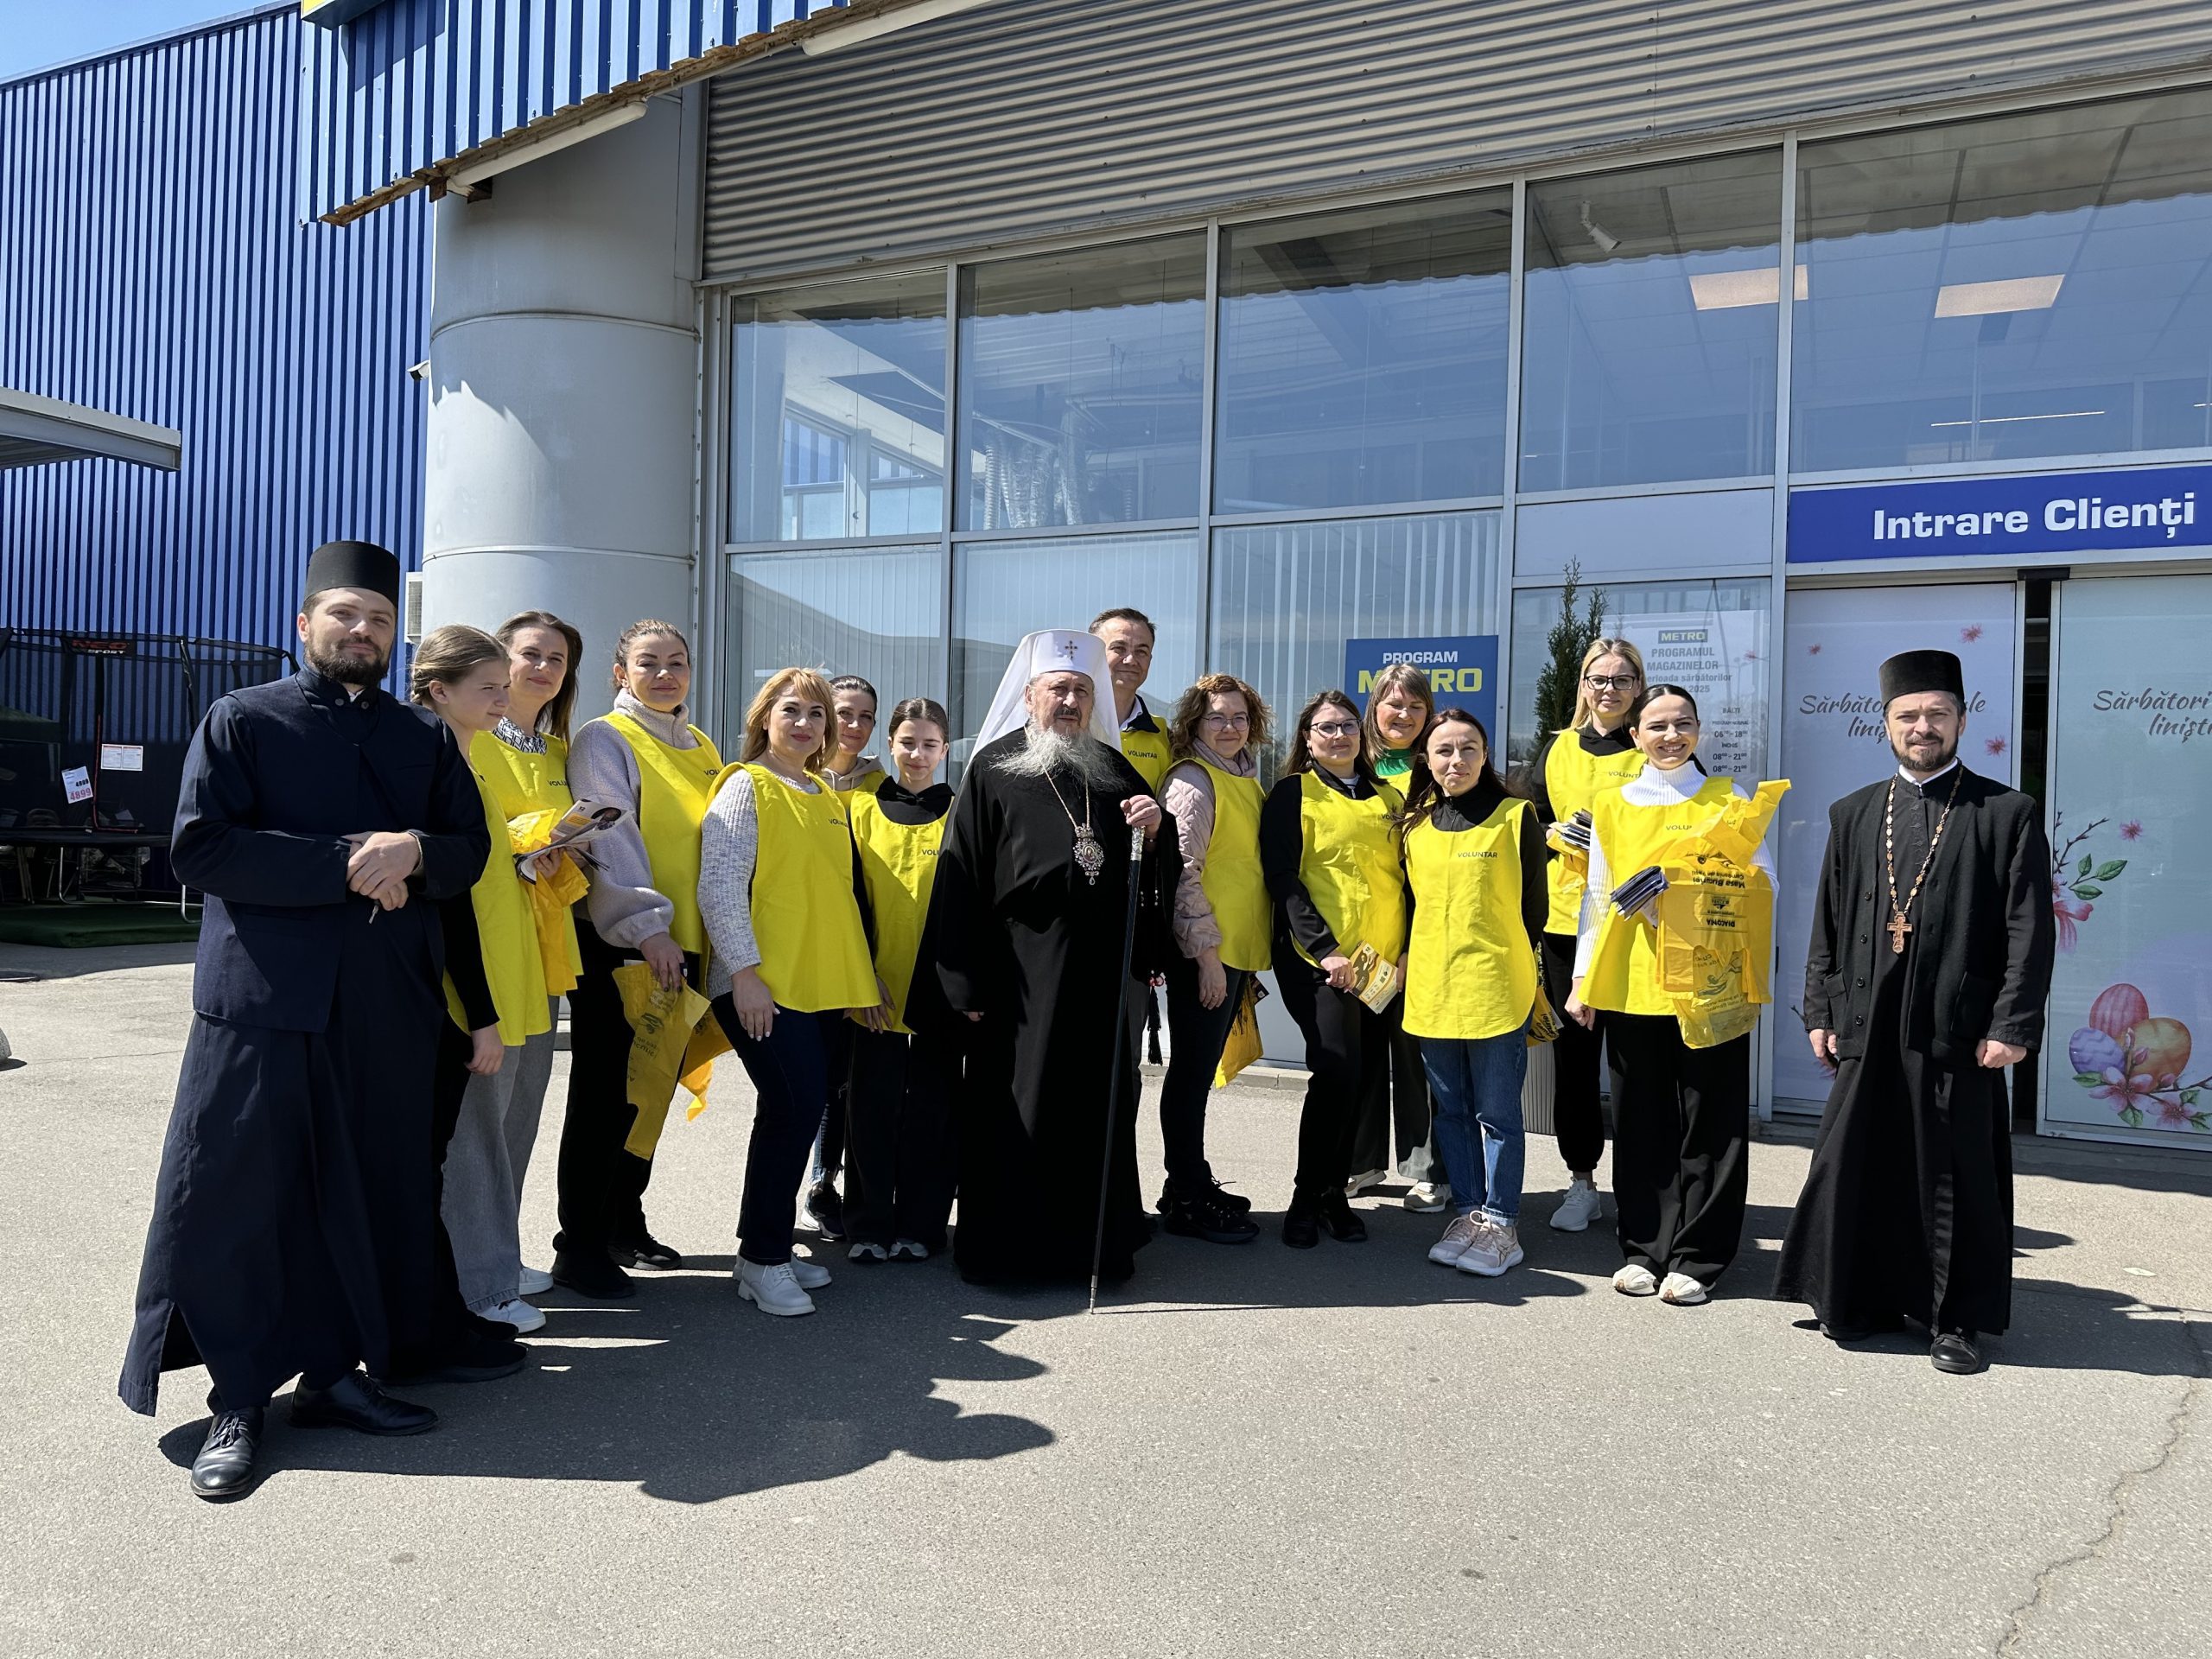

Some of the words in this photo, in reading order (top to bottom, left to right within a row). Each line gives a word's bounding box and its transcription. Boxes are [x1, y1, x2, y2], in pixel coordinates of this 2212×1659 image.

[1873, 509, 2029, 540] Intrare
[2044, 492, 2196, 539] Clienți
[1661, 632, 1706, 641] METRO
[1382, 651, 1459, 664] PROGRAM
[1651, 647, 1714, 658] PROGRAMUL
[1647, 660, 1719, 671] MAGAZINELOR
[1357, 667, 1483, 693] MRO
[1647, 674, 1678, 683] erioada
[1689, 684, 1711, 693] 2025
[1799, 691, 1885, 715] Sărbăto
[2093, 687, 2212, 711] Sărbători
[1847, 716, 1885, 744] liniș
[1127, 749, 1158, 759] VOLUNTAR
[70, 787, 92, 801] 4899
